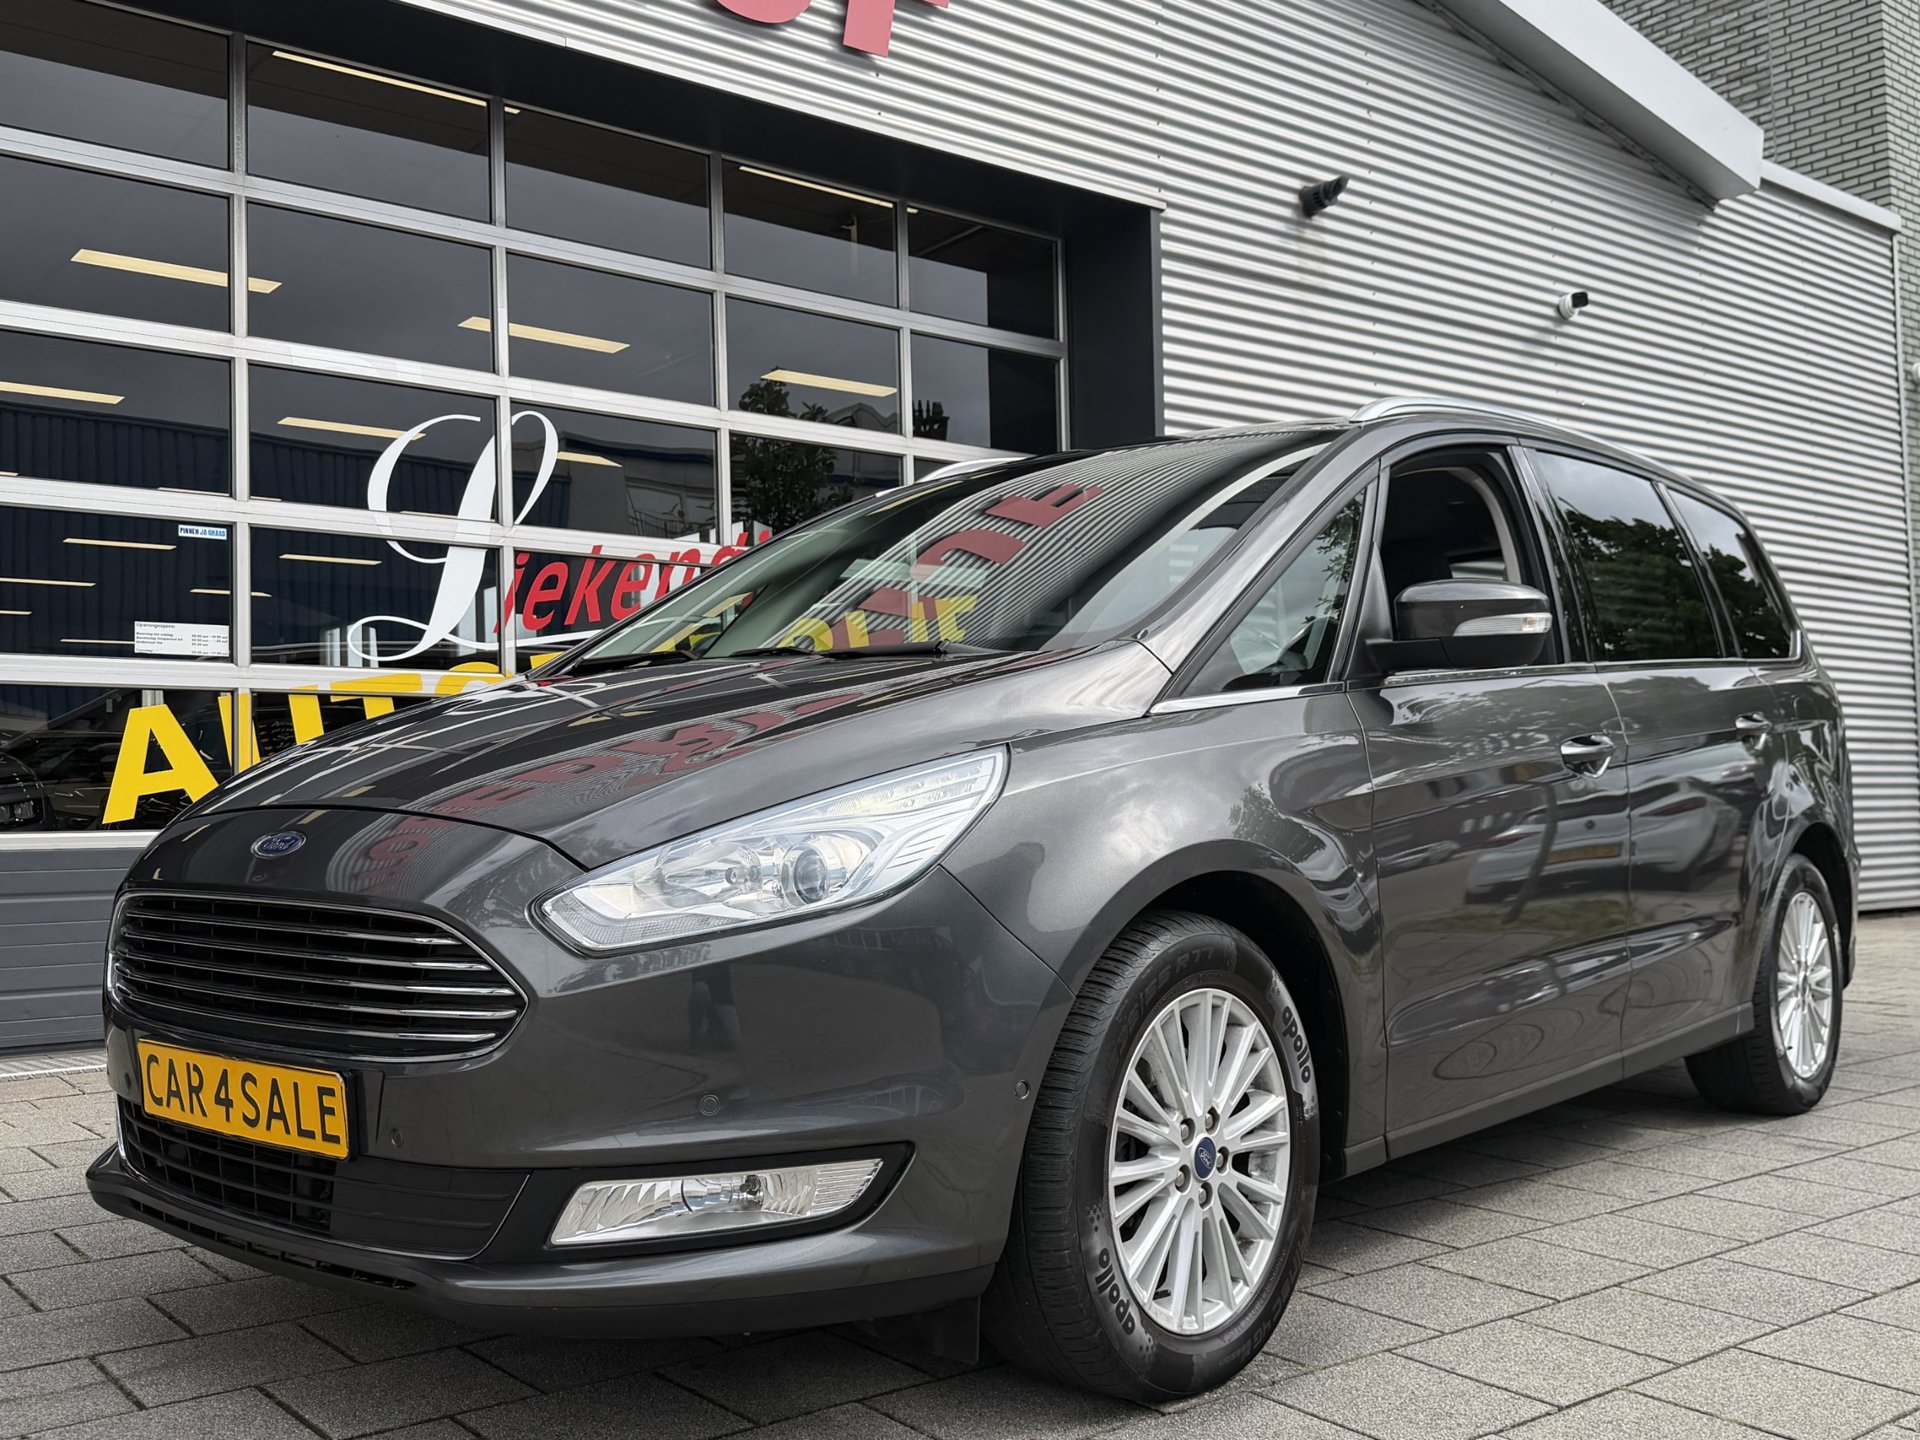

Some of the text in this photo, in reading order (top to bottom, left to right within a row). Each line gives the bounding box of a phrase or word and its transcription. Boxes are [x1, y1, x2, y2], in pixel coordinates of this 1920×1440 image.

[1281, 1006, 1311, 1083] apollo
[146, 1054, 341, 1144] CAR 4 SALE
[1095, 1248, 1135, 1335] apollo
